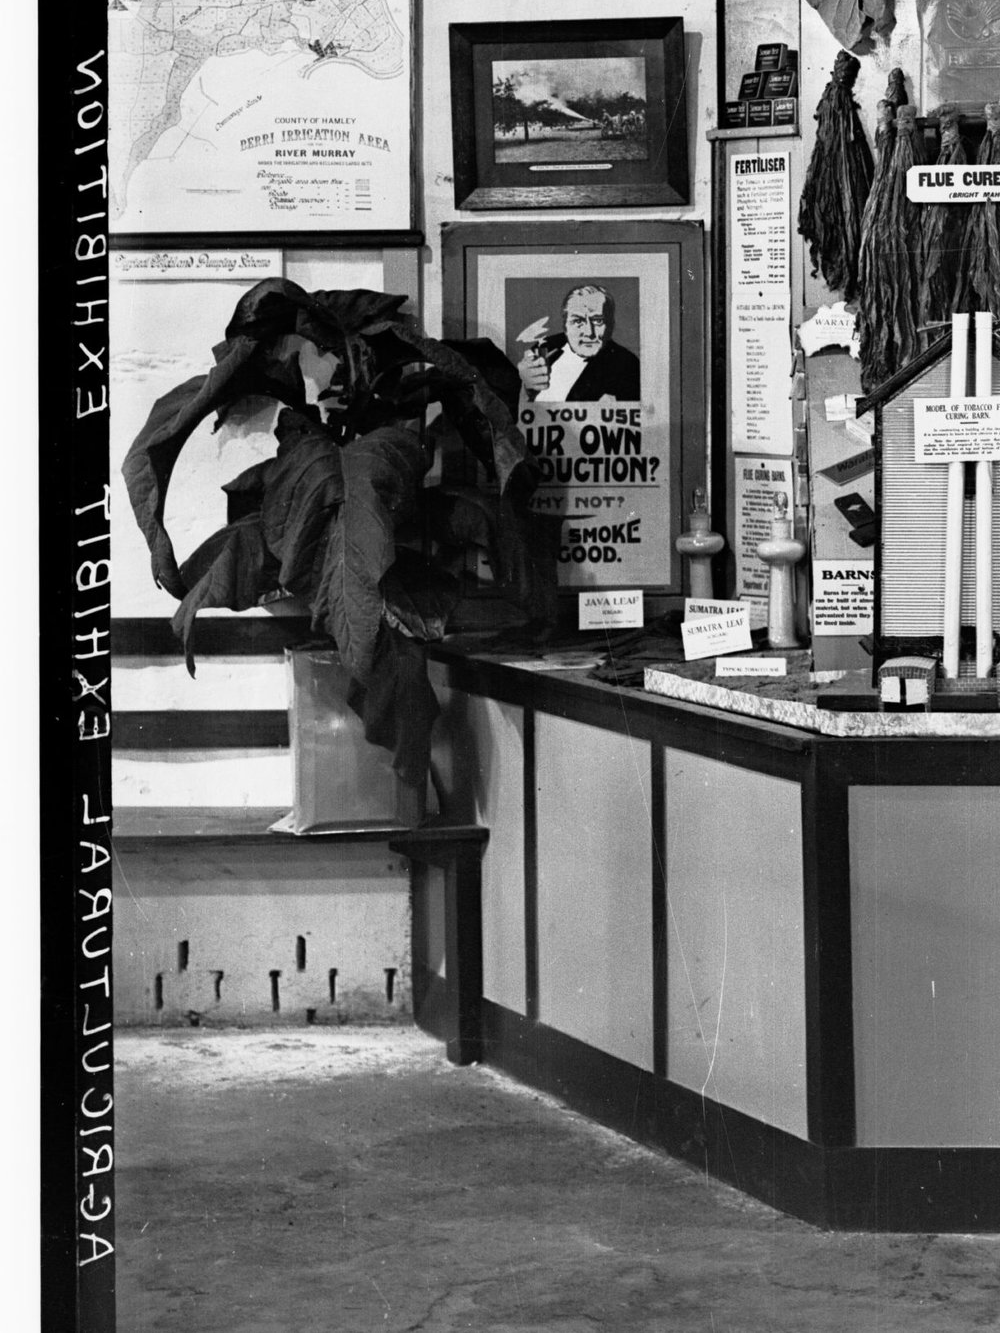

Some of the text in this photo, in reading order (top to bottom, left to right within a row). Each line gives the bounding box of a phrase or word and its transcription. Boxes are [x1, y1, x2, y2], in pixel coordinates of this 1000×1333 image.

[239, 128, 391, 152] BERRI IRRIGATION AREA
[275, 149, 356, 157] RIVER MURRAY
[735, 158, 785, 174] FERTILISER
[918, 172, 954, 187] FLUE
[926, 405, 947, 413] MODEL
[951, 404, 960, 412] OF
[964, 403, 993, 412] TOBACCO
[546, 408, 587, 422] YOU
[601, 408, 641, 427] USE
[945, 412, 969, 420] CURING
[580, 424, 642, 456] OWN
[537, 456, 660, 483] DUCTION?
[754, 469, 770, 482] CURING
[575, 495, 625, 509] NOT?
[568, 518, 641, 544] SMOKE
[558, 545, 622, 564] GOOD.
[584, 595, 639, 607] JAVA LEAF
[688, 604, 723, 615] SUMATRA
[687, 618, 744, 636] SUMATRA LEAF
